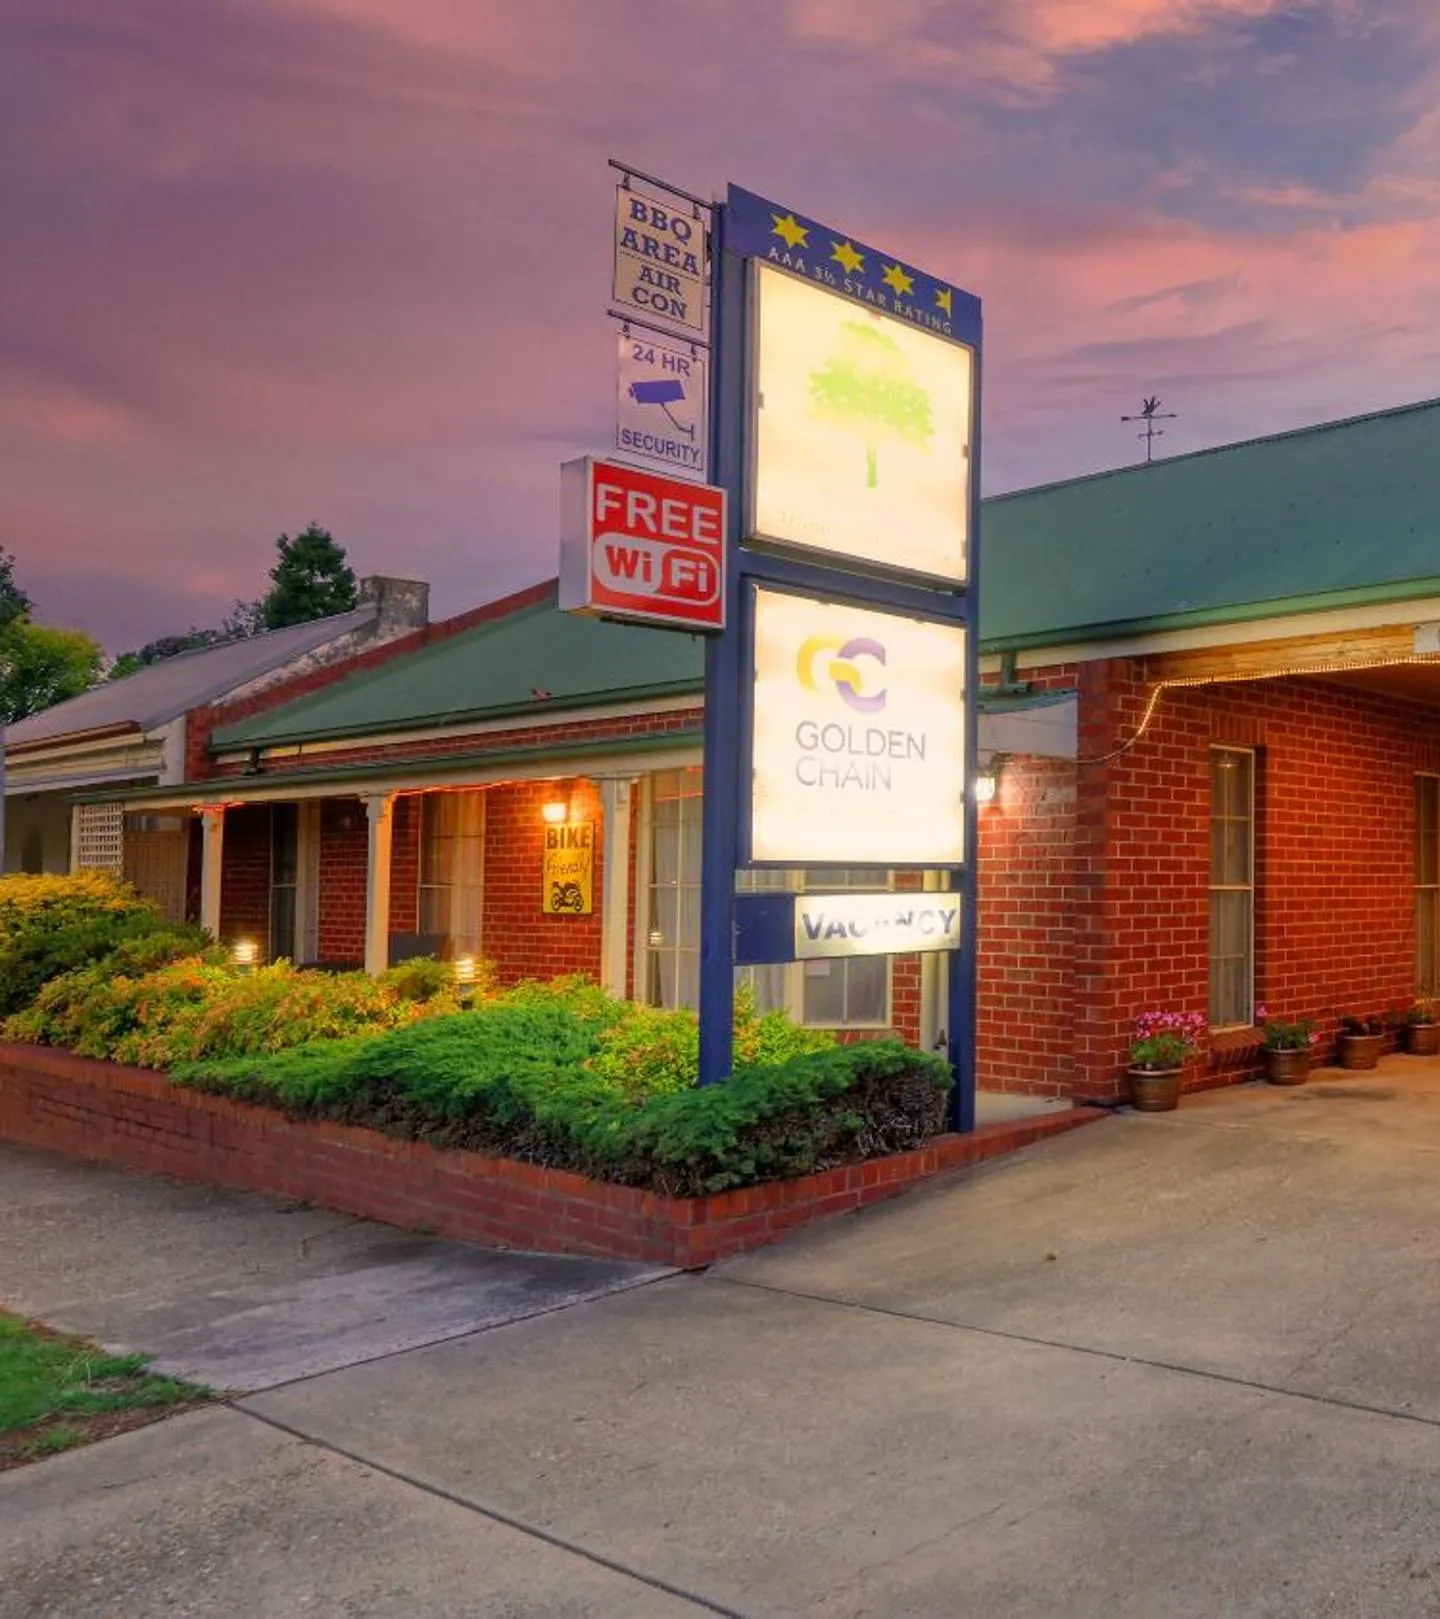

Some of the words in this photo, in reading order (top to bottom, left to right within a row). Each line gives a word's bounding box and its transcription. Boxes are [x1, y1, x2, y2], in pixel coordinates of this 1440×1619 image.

[630, 198, 692, 246] BBQ
[620, 226, 700, 275] AREA
[639, 264, 683, 296] AIR
[768, 246, 806, 273] AAA
[844, 278, 887, 307] STAR
[894, 300, 952, 335] RATING
[631, 286, 688, 319] CON
[632, 343, 655, 365] 24
[662, 353, 691, 377] HR
[621, 428, 700, 463] SECURITY
[596, 482, 719, 545] FREE
[795, 721, 926, 760] GOLDEN
[795, 756, 892, 791] CHAIN
[546, 826, 591, 850] BIKE
[802, 909, 957, 940] VACNCY
